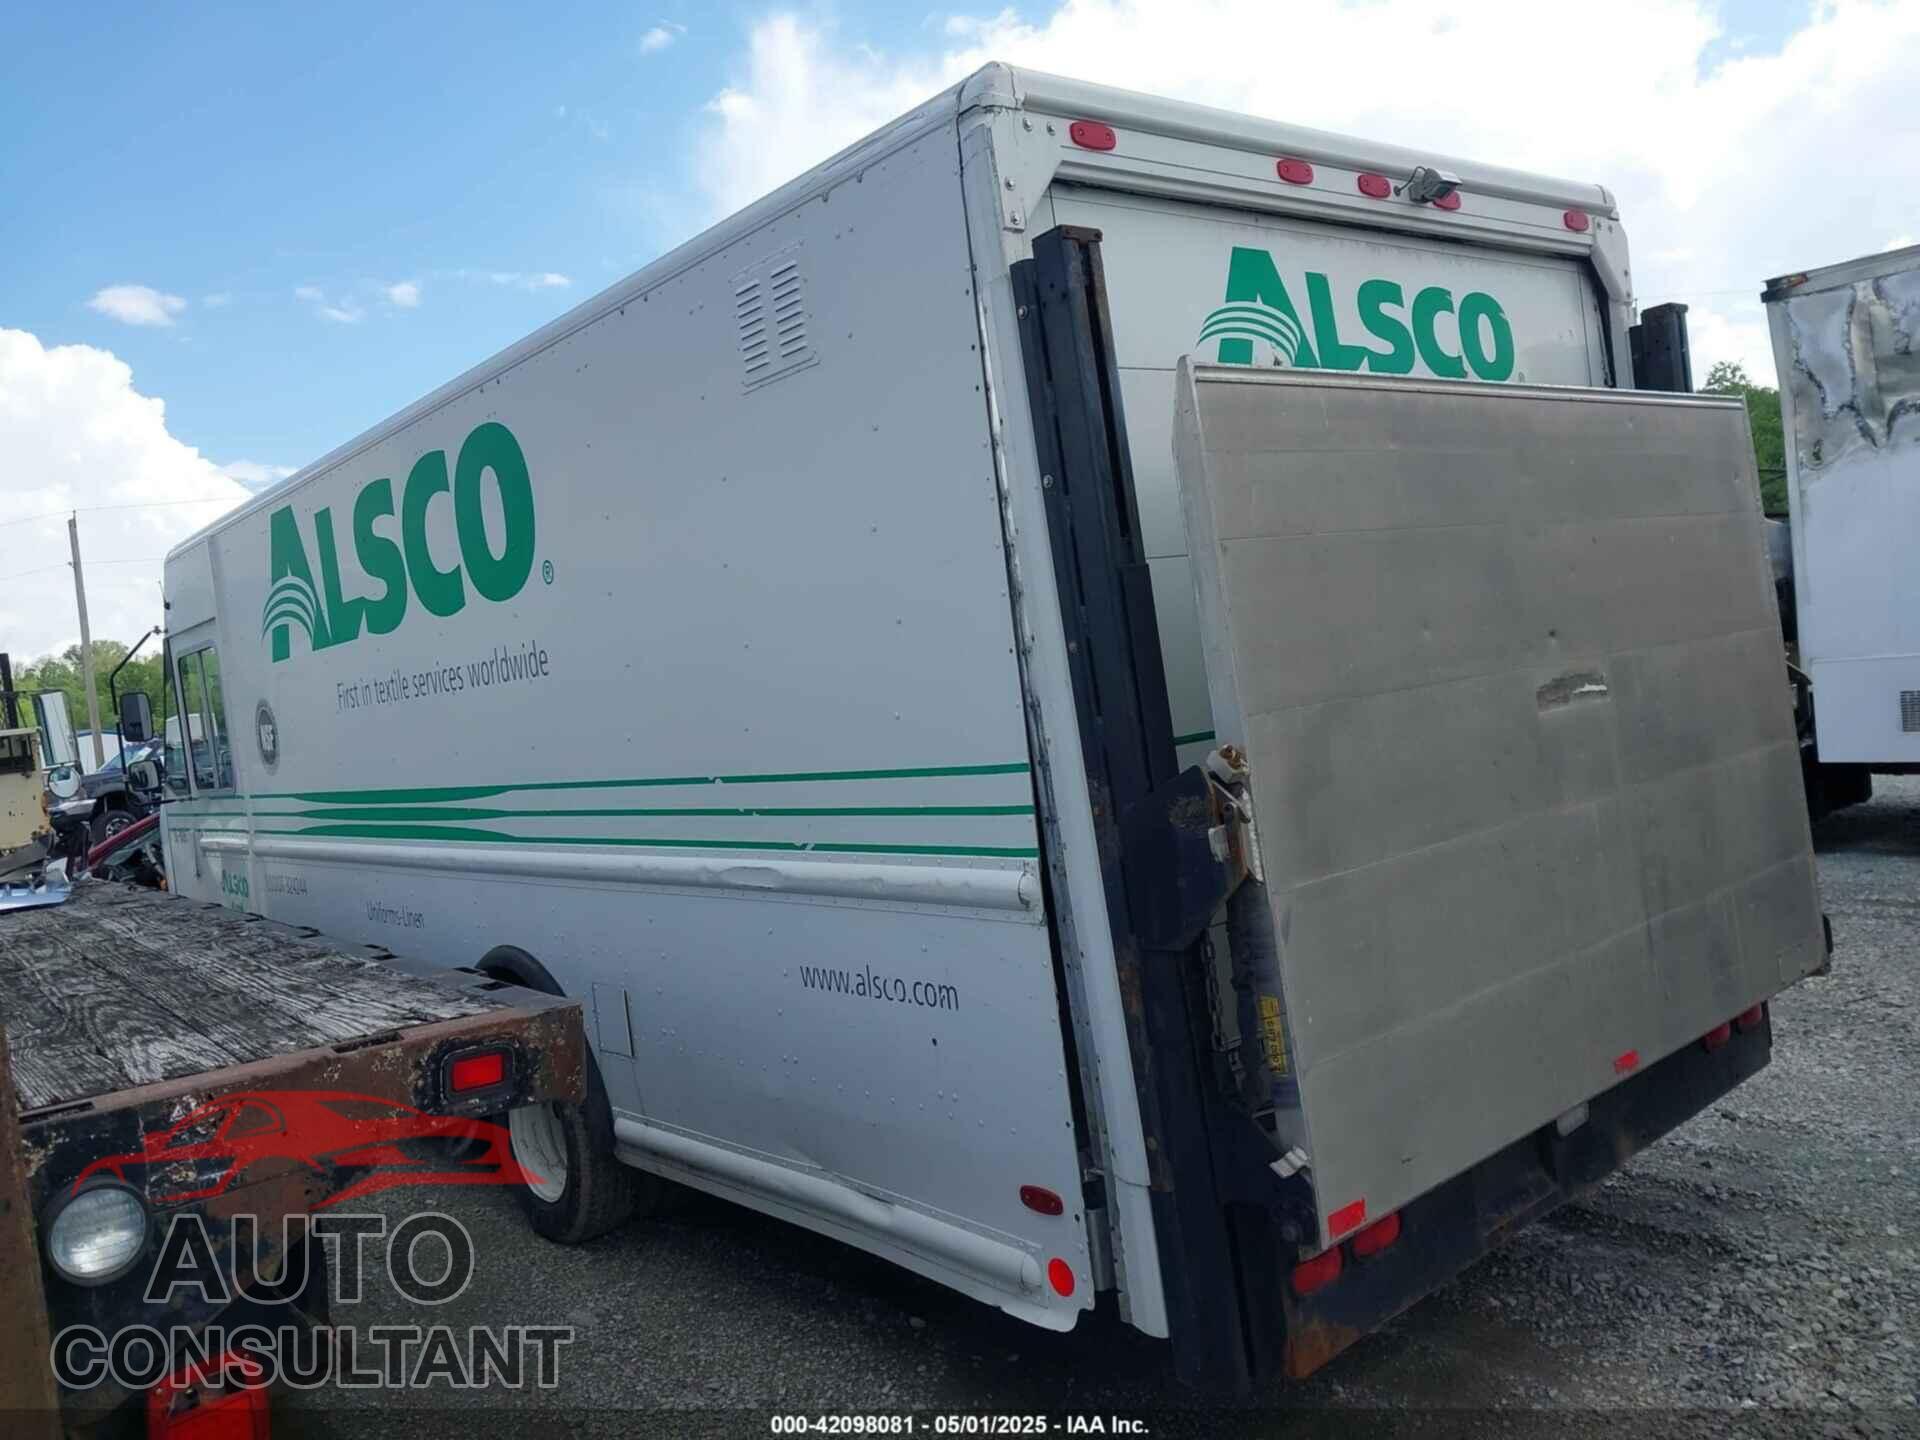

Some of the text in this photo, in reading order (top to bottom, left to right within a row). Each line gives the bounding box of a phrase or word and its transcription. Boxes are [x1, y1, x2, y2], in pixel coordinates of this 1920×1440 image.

[1197, 246, 1515, 382] ALSCO
[261, 421, 536, 663] ALSCO
[336, 639, 550, 711] First in textile services worldwide
[799, 963, 960, 1011] www.alsco.com
